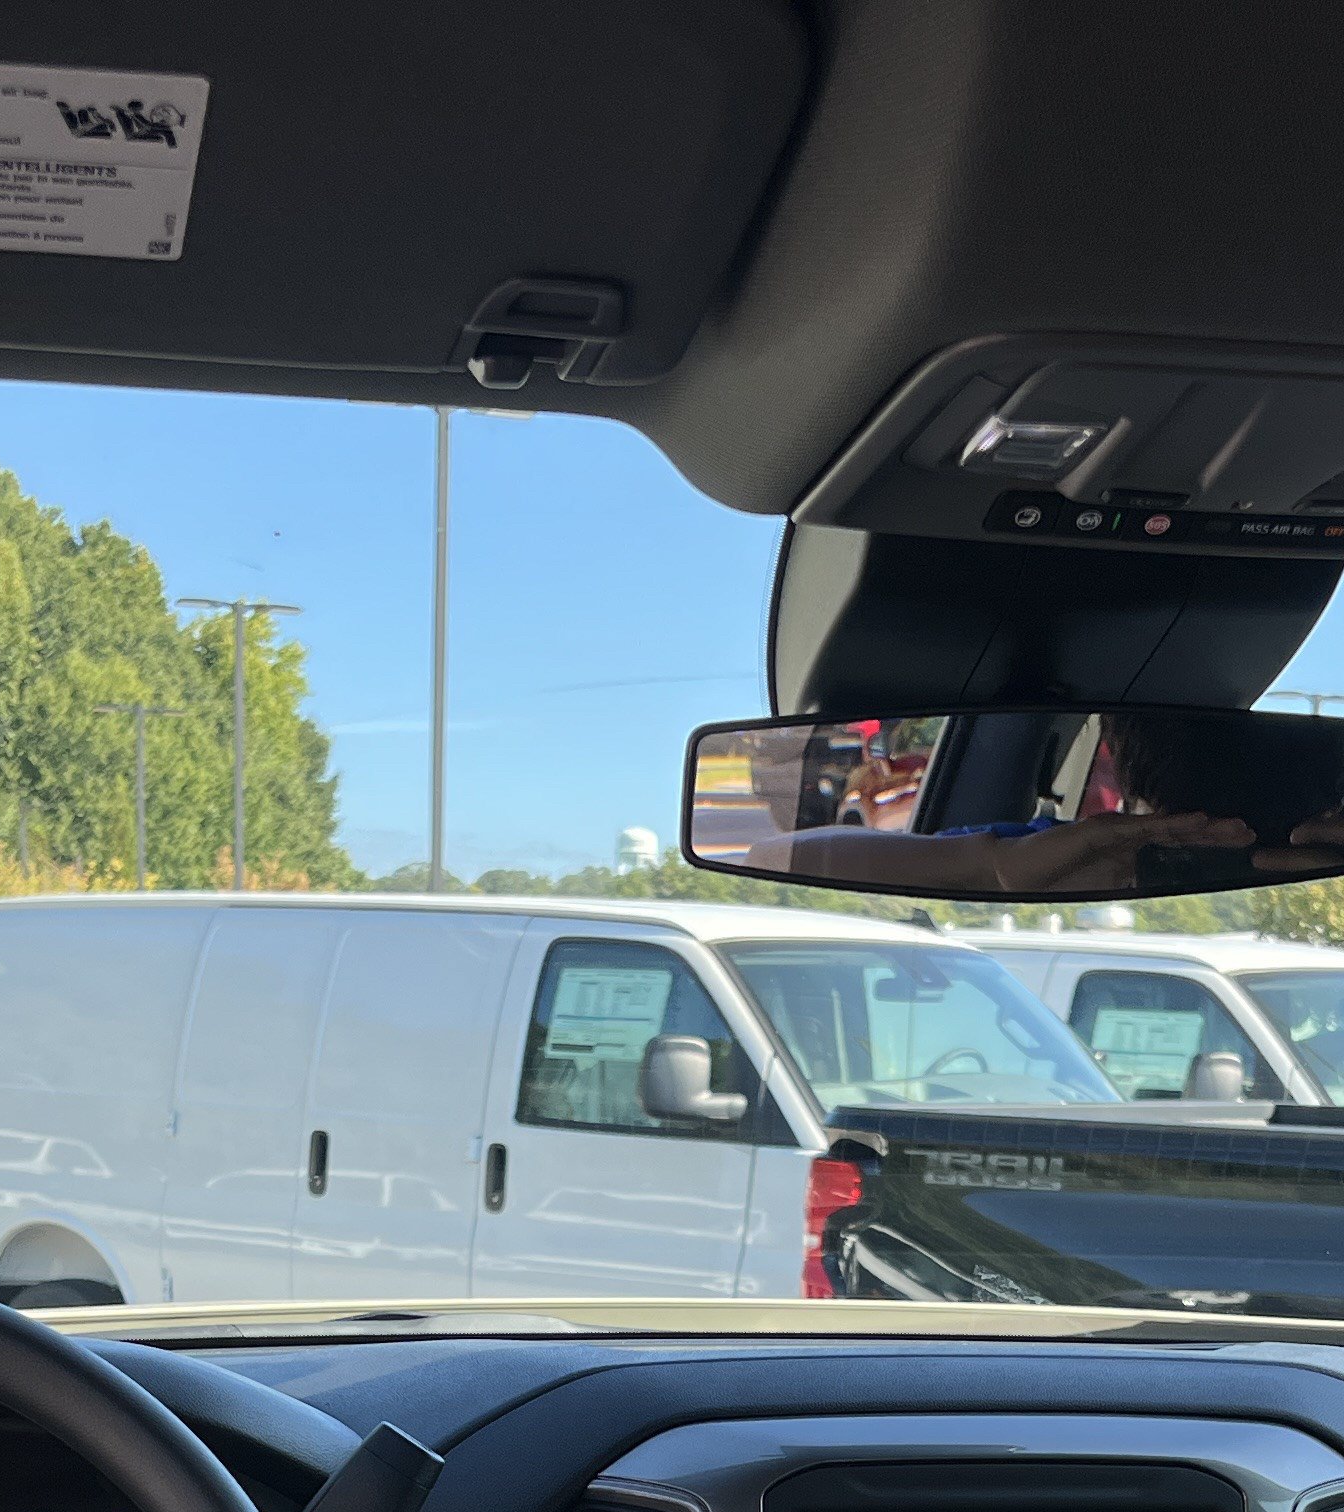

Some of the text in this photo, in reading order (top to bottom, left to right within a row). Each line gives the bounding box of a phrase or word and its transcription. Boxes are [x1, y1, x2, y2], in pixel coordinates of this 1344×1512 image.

[1241, 523, 1344, 537] PASS AIR BAG OFF
[903, 1148, 1089, 1176] TRAIL
